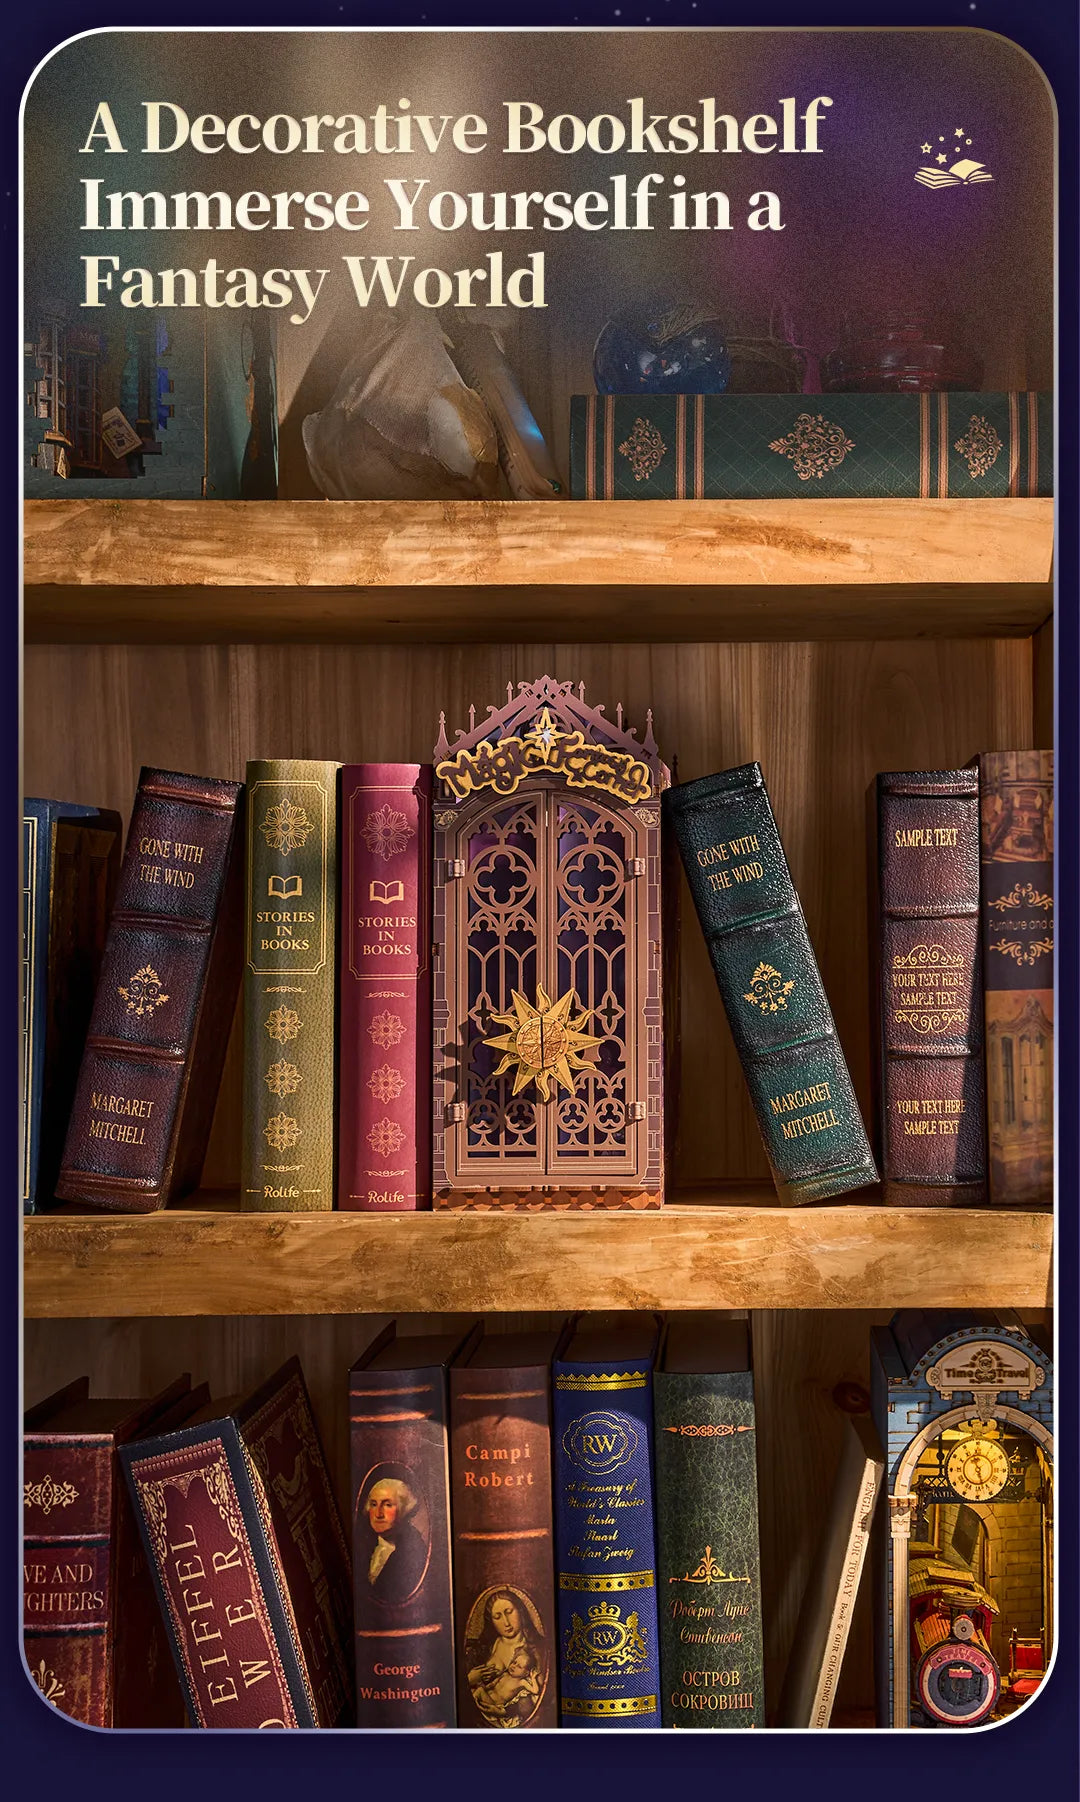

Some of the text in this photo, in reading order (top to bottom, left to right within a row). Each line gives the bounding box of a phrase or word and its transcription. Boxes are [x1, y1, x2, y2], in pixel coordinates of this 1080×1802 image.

[895, 828, 958, 848] SAMPLE TEXT
[139, 836, 204, 864] GONE WITH
[697, 834, 761, 867] GONE WITH
[140, 863, 195, 889] THE WIND
[707, 862, 764, 892] THE WIND
[256, 911, 315, 923] STORIES
[358, 916, 417, 928] STORIES
[276, 925, 293, 937] IN
[378, 930, 395, 942] IN
[261, 939, 310, 951] BOOKS
[363, 944, 412, 956] BOOKS
[892, 973, 917, 987] YOUR
[900, 991, 958, 1006] SAMPLE TEXT
[90, 1091, 155, 1118] MARGARET
[769, 1081, 832, 1115] MARGARET
[896, 1099, 967, 1114] YOUR TEXT HERE
[781, 1108, 840, 1140] MITCHELL
[903, 1120, 960, 1135] SAMPLE TEXT
[263, 1184, 300, 1198] Rolife
[367, 1190, 405, 1204] Rolife
[944, 1367, 1029, 1378] Time Travel
[581, 1433, 618, 1454] RW
[465, 1443, 531, 1465] Campi
[464, 1471, 534, 1487] Robert
[578, 1481, 624, 1496] Treasury
[625, 1478, 638, 1495] of
[567, 1496, 646, 1509] World's Classics
[856, 1481, 876, 1530] ENGLISH
[850, 1534, 864, 1556] FOR
[51, 1563, 93, 1584] AND
[842, 1560, 859, 1598] TODAY
[23, 1590, 104, 1612] GHTERS
[171, 1524, 239, 1707] EIFFEL
[838, 1602, 849, 1620] Book
[592, 1630, 619, 1646] RW
[831, 1633, 842, 1652] OUR
[373, 1662, 421, 1679] George
[682, 1670, 740, 1687] ОСТРОВ
[821, 1654, 837, 1702] CHANGING
[360, 1686, 441, 1703] Washington
[671, 1691, 755, 1711] СОКРОВИЩ
